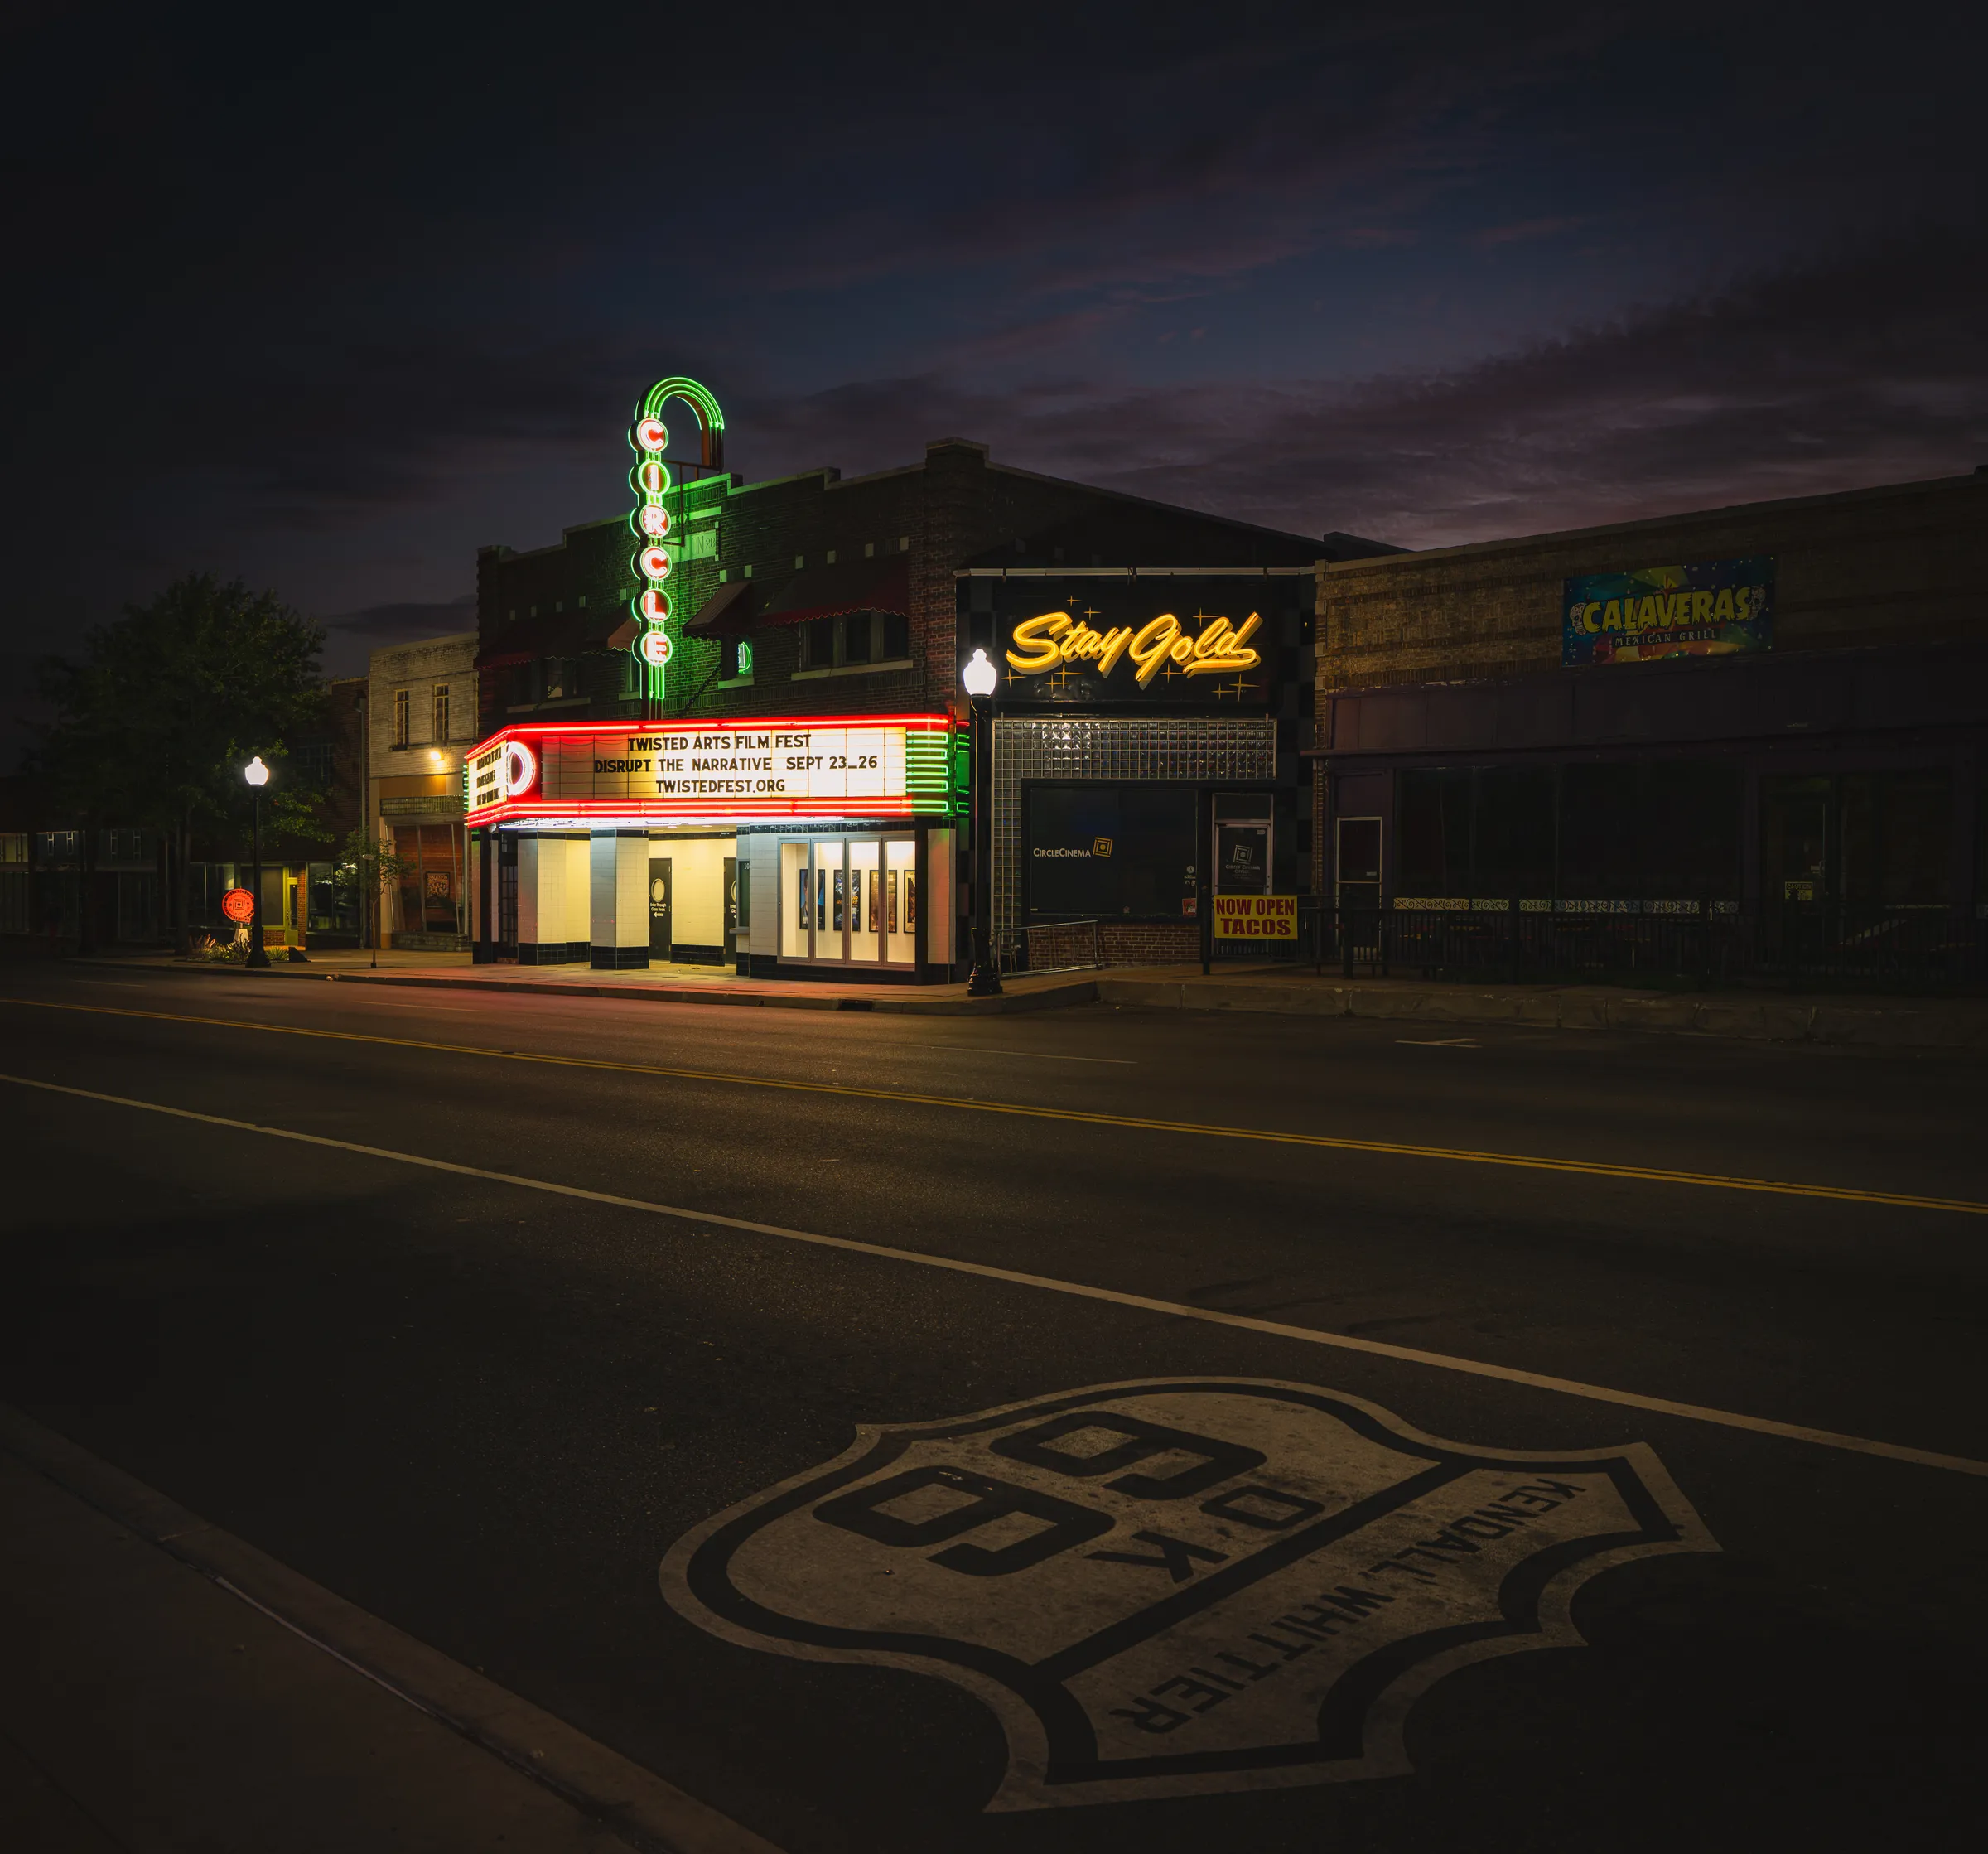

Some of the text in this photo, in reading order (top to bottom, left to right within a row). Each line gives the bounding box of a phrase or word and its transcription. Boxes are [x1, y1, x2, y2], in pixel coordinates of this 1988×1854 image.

[639, 418, 669, 661] CIRCLE
[1582, 587, 1751, 634] CALAVERAS
[1006, 610, 1260, 684] Stay Gold
[1614, 630, 1717, 647] MEXICAN GRILL
[628, 734, 811, 751] TWISTED ARTS FILM FEST
[594, 759, 651, 773] DISRUPT
[658, 758, 684, 771] THE
[692, 757, 772, 771] NARRATIVE
[786, 756, 823, 770] SEPT
[655, 778, 785, 793] TWISTEDFEST.ORG
[1216, 898, 1295, 915] NOW OPEN
[1220, 918, 1291, 935] TACOS
[1109, 1586, 1396, 1734] WHITTIER
